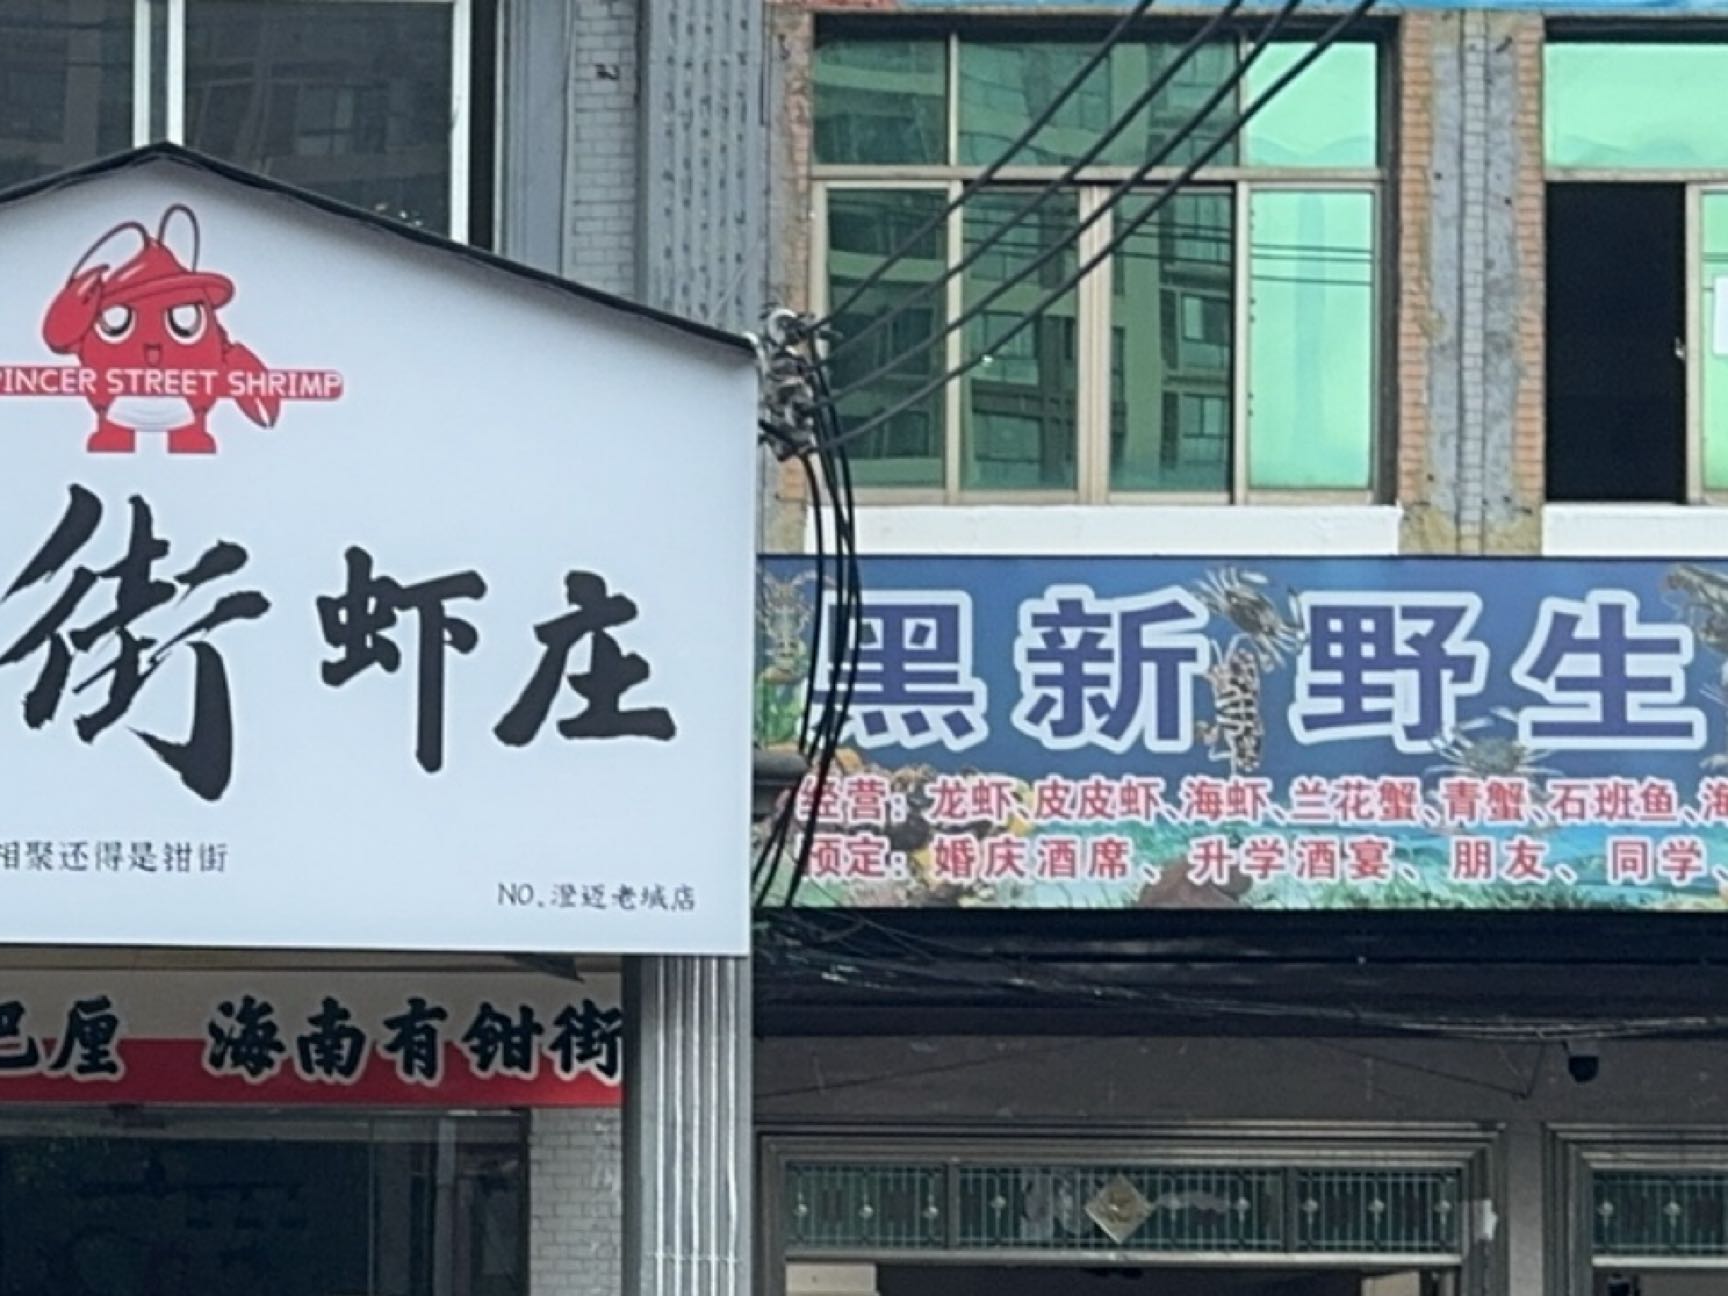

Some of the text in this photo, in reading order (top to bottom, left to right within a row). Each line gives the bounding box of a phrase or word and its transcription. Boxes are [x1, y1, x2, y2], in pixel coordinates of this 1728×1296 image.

[105, 369, 219, 395] STREET
[227, 371, 342, 398] SHRIMP
[1302, 600, 1696, 744] 野生
[207, 995, 621, 1079] 海南有钳街
